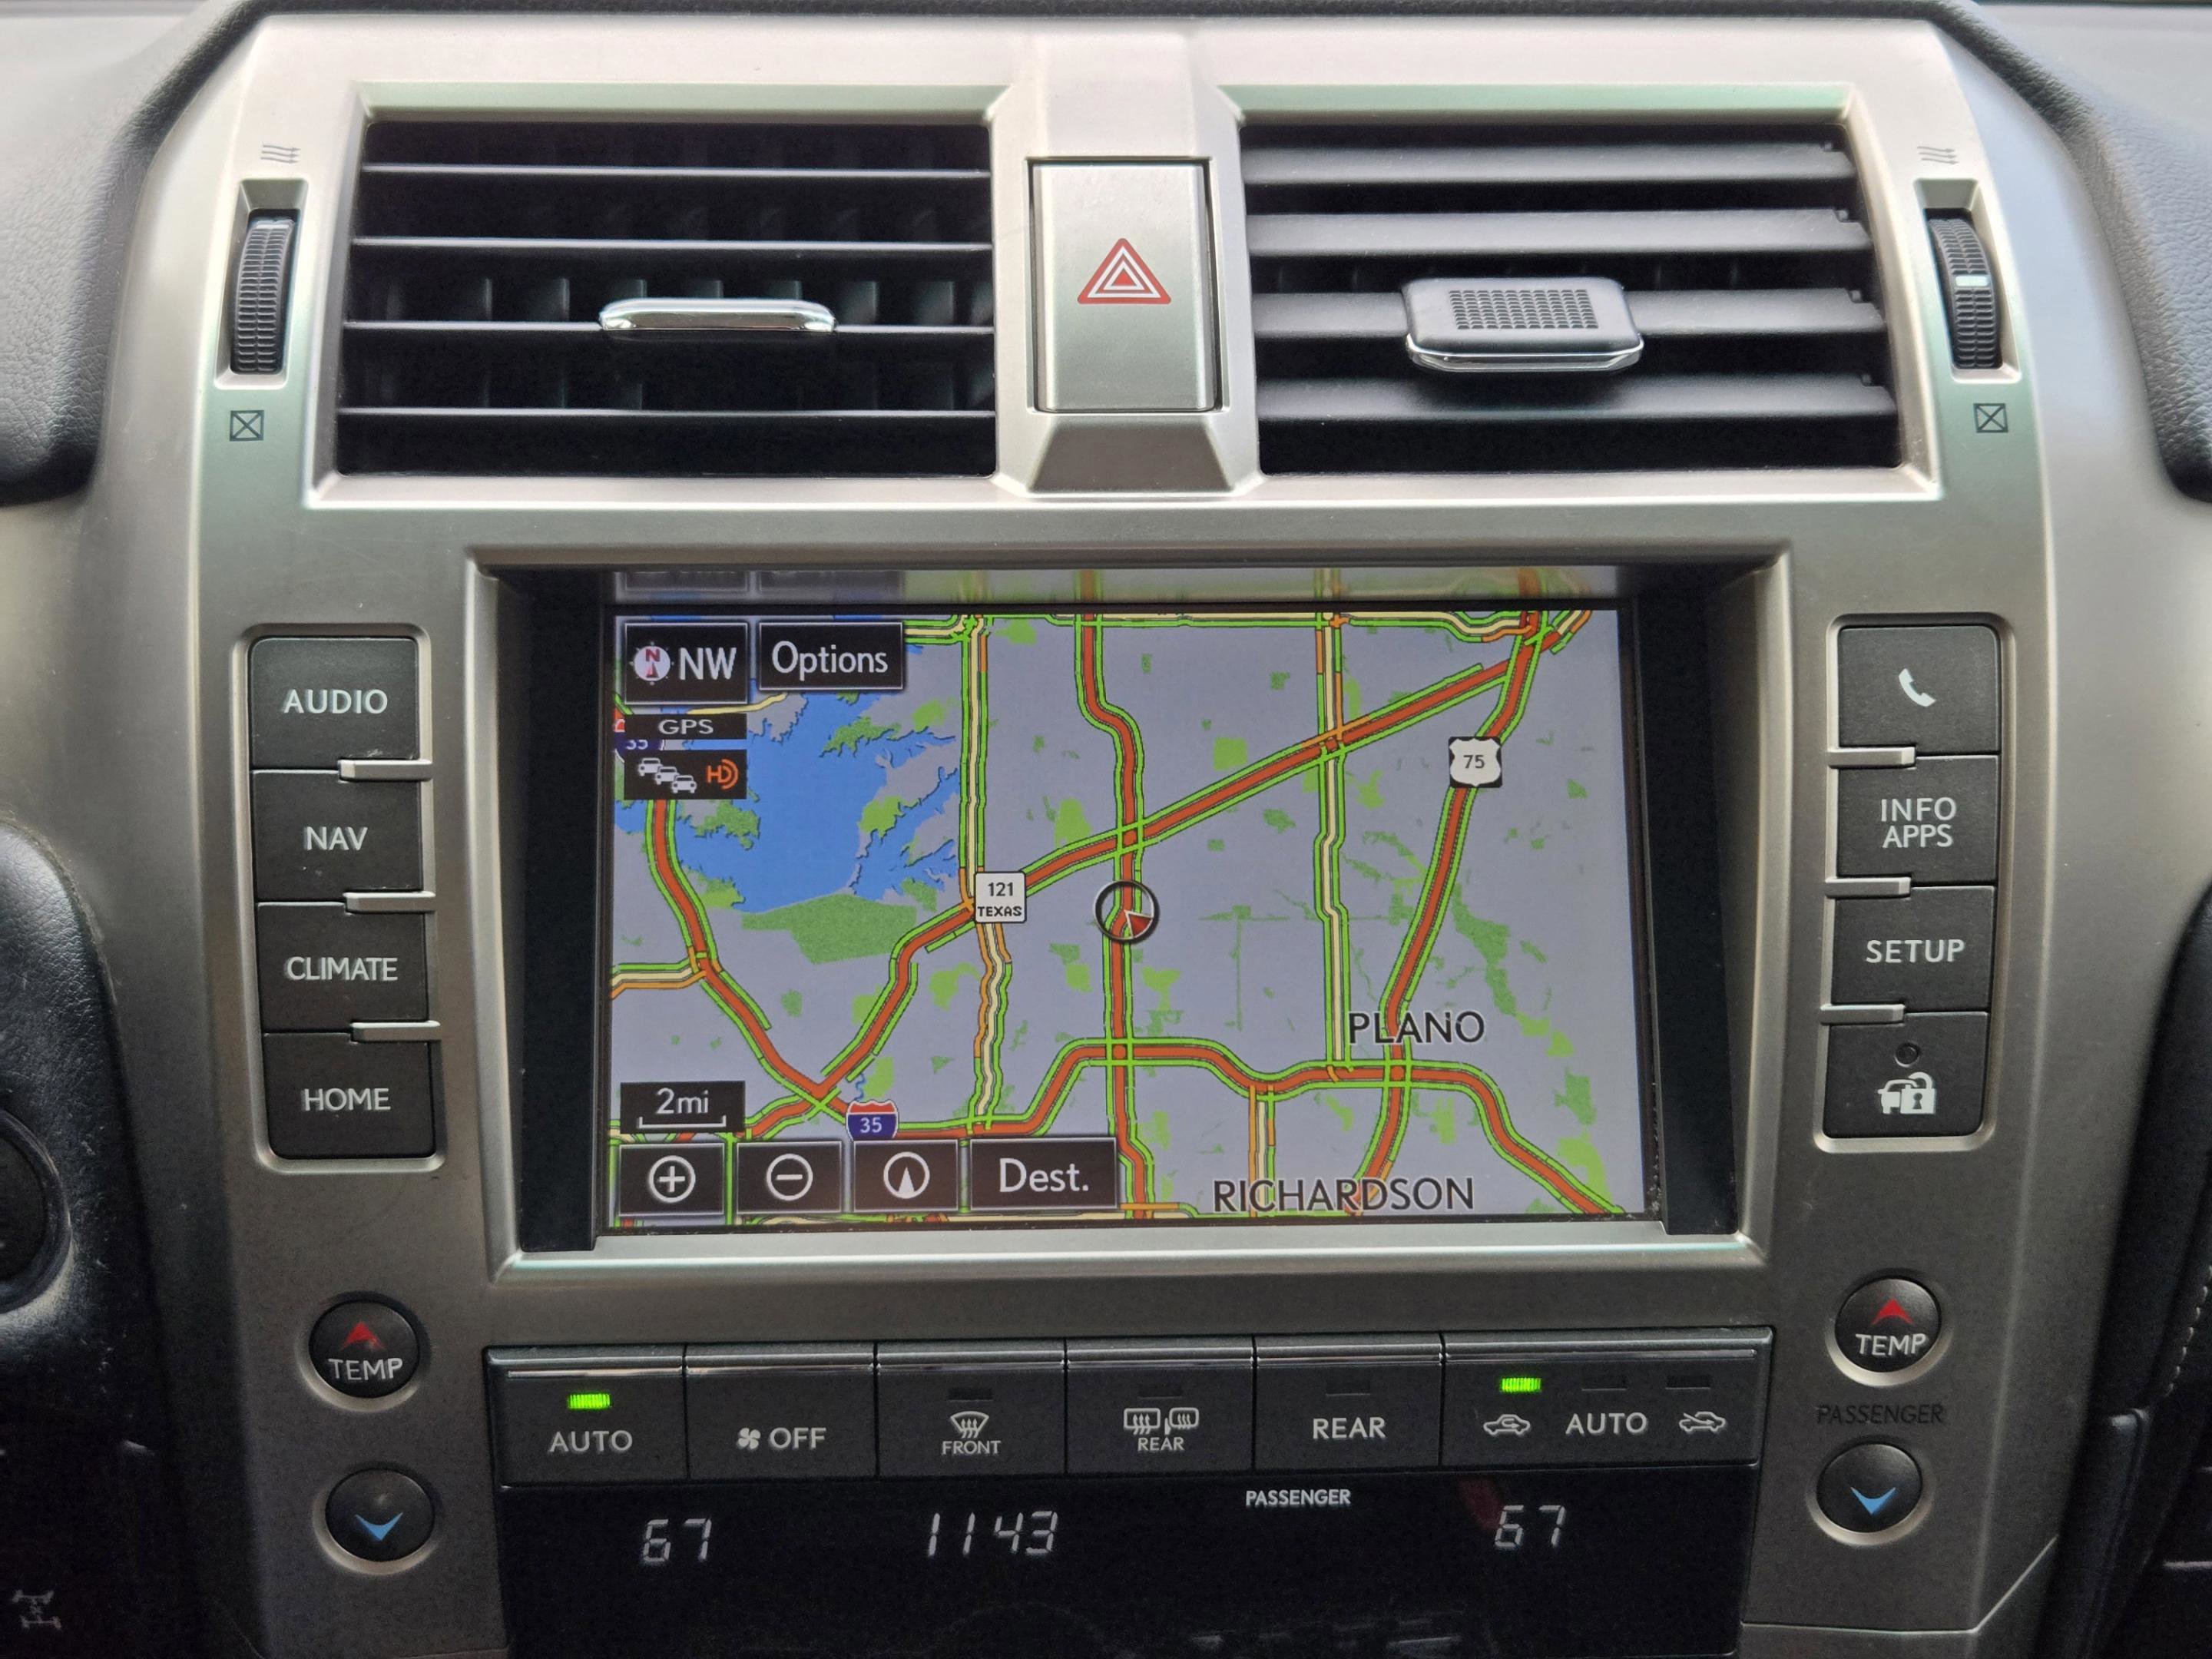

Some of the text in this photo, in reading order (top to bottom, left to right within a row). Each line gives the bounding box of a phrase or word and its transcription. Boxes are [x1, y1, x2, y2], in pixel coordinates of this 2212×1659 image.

[680, 647, 737, 680] NW
[771, 640, 889, 680] Options
[280, 688, 388, 714] AUDIO
[657, 718, 714, 735] GPS
[1462, 754, 1485, 770] 75
[1881, 796, 1956, 822] INFO
[302, 826, 368, 852] NAV
[1882, 823, 1953, 849] APPS
[987, 882, 1014, 898] 121
[977, 905, 1022, 918] TEXAS
[1866, 939, 1965, 963] SETUP
[283, 956, 399, 982] CLIMATE
[1349, 1011, 1485, 1045] PLANO
[300, 1087, 391, 1111] HOME
[655, 1088, 710, 1116] 2mi
[859, 1116, 883, 1134] 35
[999, 1157, 1089, 1193] Dest.
[1214, 1177, 1474, 1213] RICHARDSON
[1855, 1333, 1928, 1357] TEMP
[328, 1356, 404, 1382] TEMP
[1565, 1412, 1649, 1436] AUTO
[1816, 1404, 1946, 1426] PASSENGER
[768, 1426, 827, 1450] OFF
[1312, 1417, 1386, 1441] REAR
[548, 1429, 633, 1454] AUTO
[941, 1439, 1002, 1455] FRONT
[1137, 1437, 1185, 1453] REAR
[1245, 1488, 1352, 1508] PASSENGER
[1494, 1504, 1567, 1550] 67
[641, 1517, 713, 1565] 67
